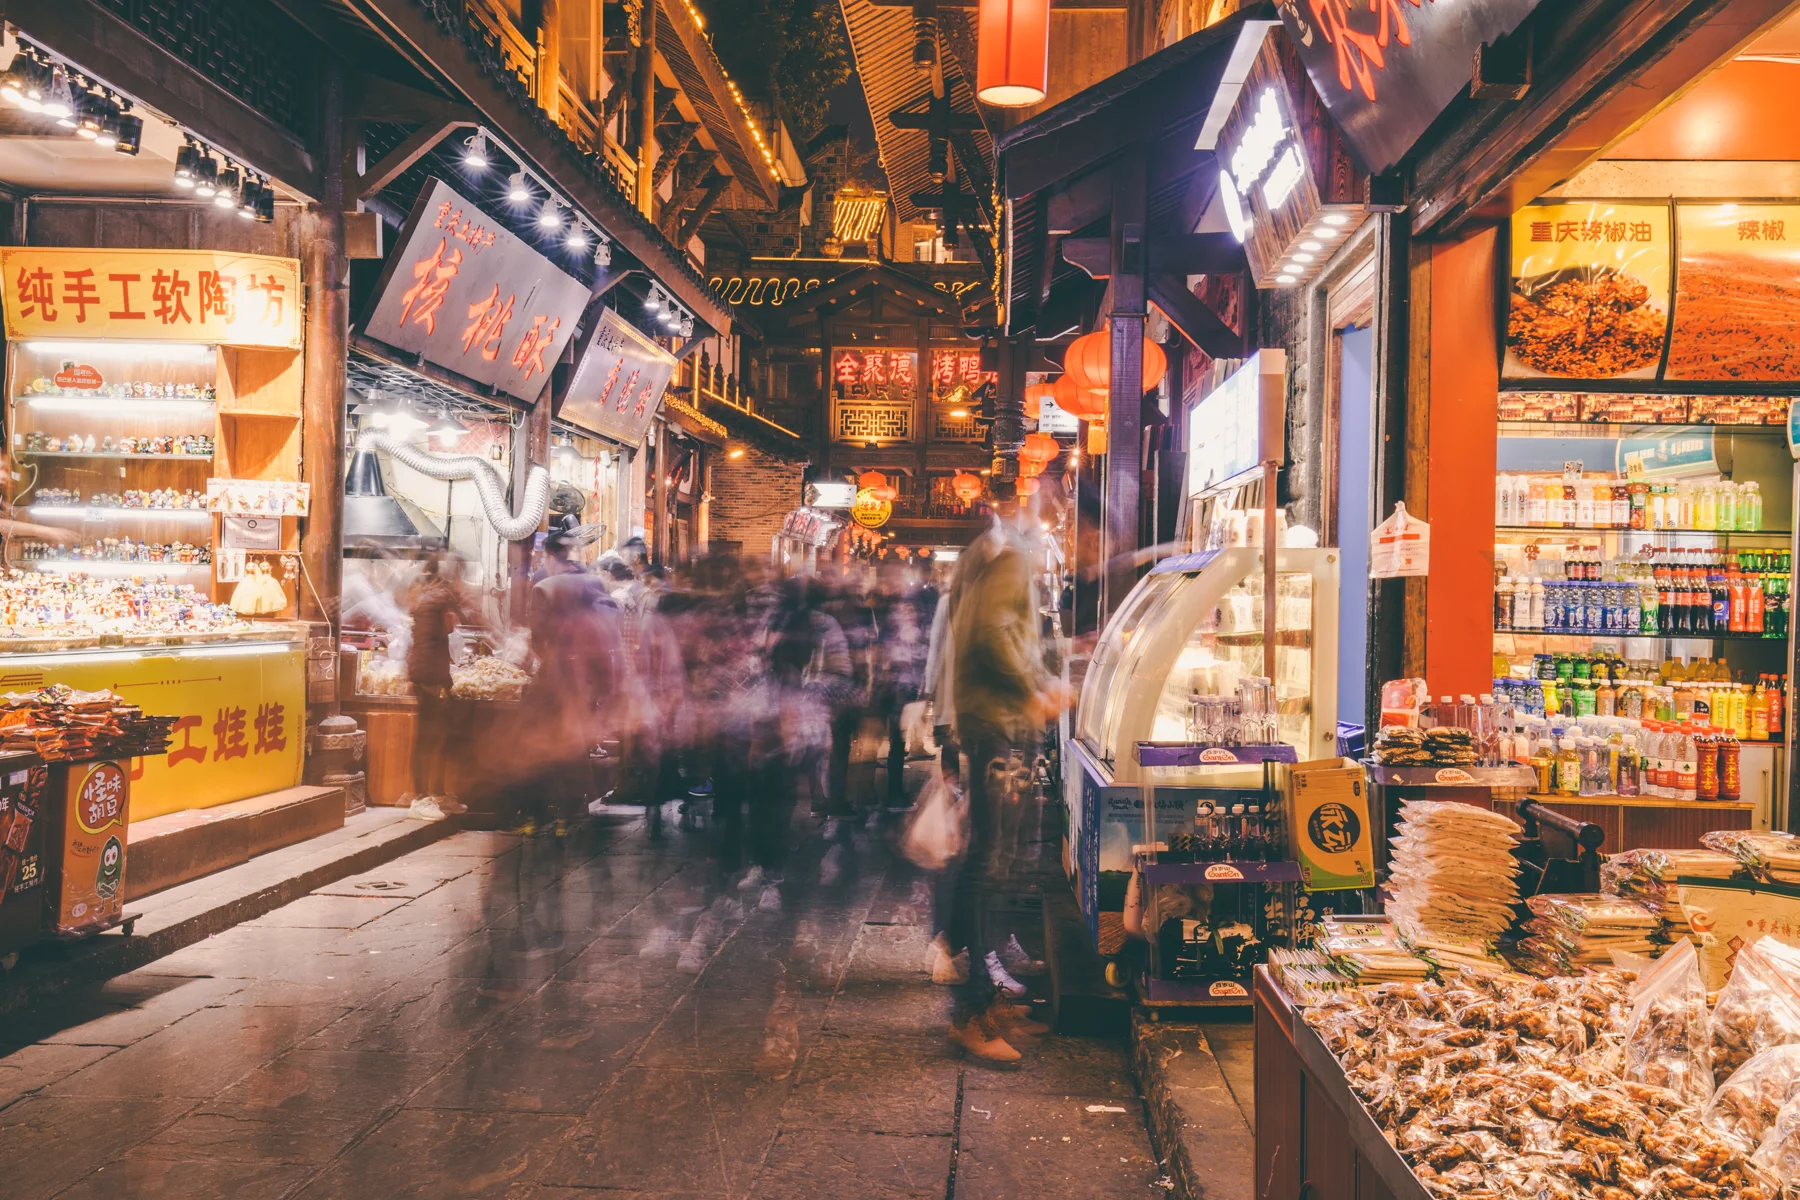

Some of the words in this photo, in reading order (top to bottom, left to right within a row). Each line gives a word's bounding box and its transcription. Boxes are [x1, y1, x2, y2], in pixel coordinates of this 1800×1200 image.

[1530, 219, 1652, 243] 重庆辣椒油
[1737, 219, 1787, 242] 辣椒
[16, 266, 285, 327] 纯手工软陶坊
[400, 237, 560, 381] 核桃酥
[835, 353, 912, 383] 全聚德
[932, 353, 998, 384] 烤鸭
[131, 701, 288, 782] 工娃娃
[84, 771, 122, 803] 怪味
[1702, 754, 1715, 790] 王老吉
[1726, 754, 1737, 790] 王老吉
[88, 795, 118, 824] 胡豆
[22, 862, 37, 880] 25
